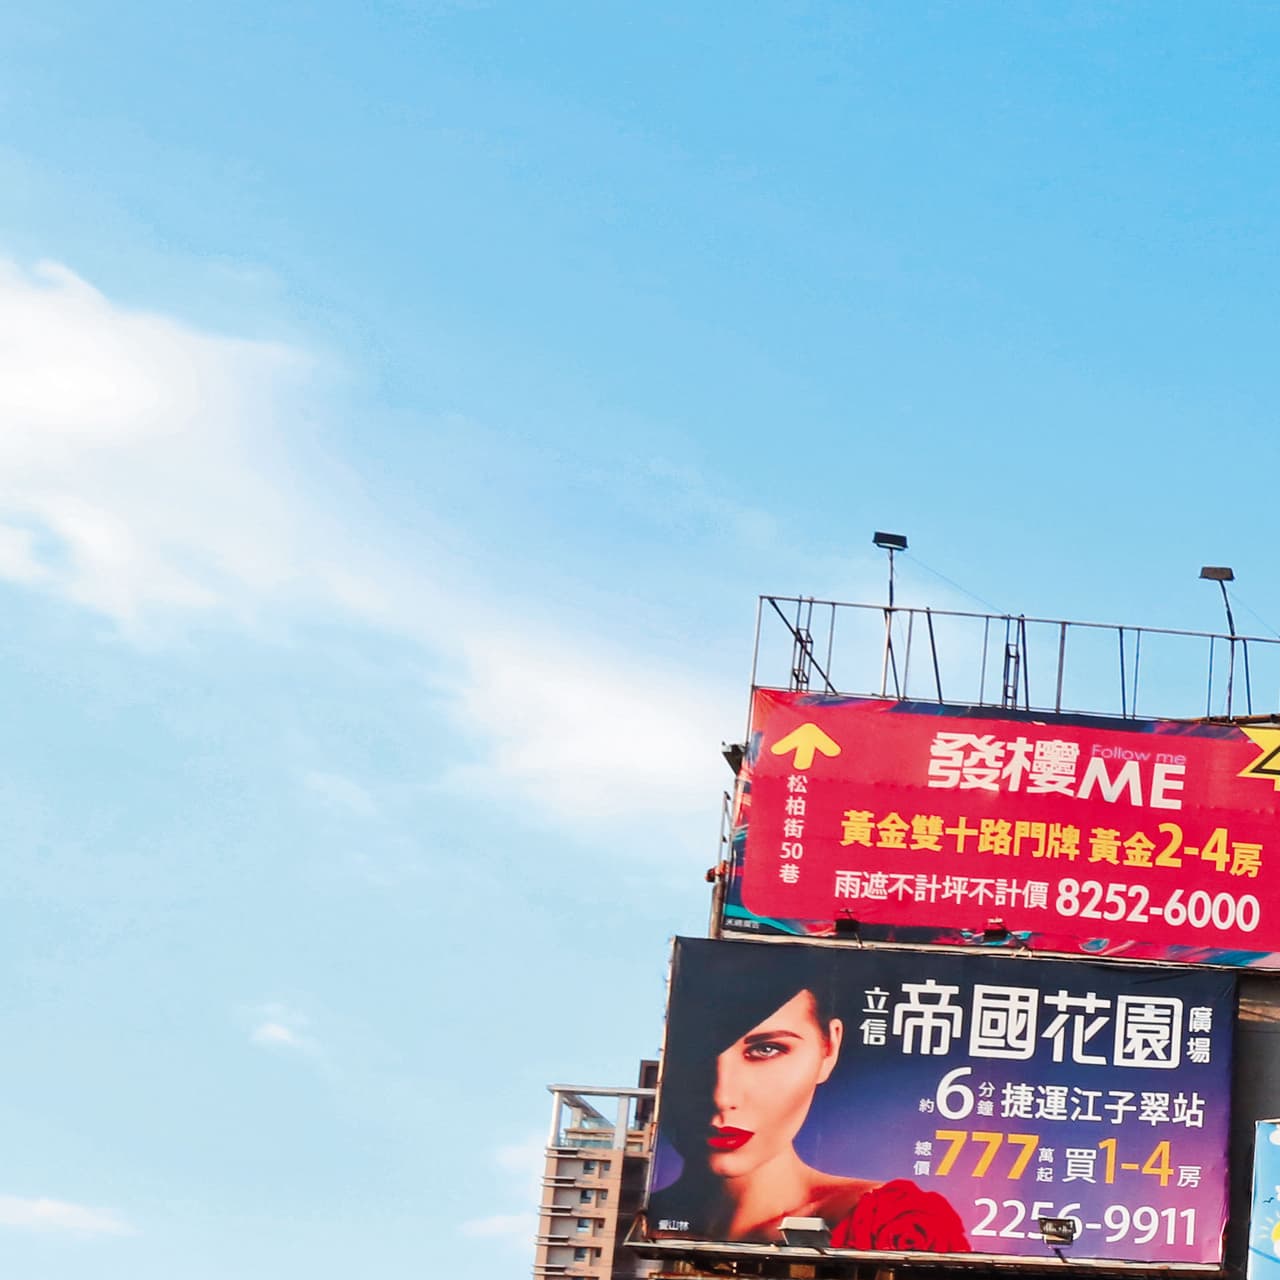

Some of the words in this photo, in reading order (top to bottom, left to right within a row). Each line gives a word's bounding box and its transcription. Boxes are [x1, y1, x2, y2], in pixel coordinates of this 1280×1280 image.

[1091, 744, 1151, 760] Follow
[1155, 753, 1187, 765] me
[778, 772, 807, 884] 松柏街50巷
[841, 810, 1080, 860] 黃金雙十路門牌
[1089, 822, 1263, 878] 黃金2-4房
[835, 870, 1048, 911] 雨遮不計坪不計價
[1055, 877, 1260, 933] 8252-6000
[860, 987, 890, 1046] 立信
[892, 979, 1184, 1069] 帝國花園
[1186, 1006, 1213, 1064] 廣場
[1001, 1082, 1206, 1128] 捷運江子翠站
[970, 1198, 1196, 1246] 2256-9911
